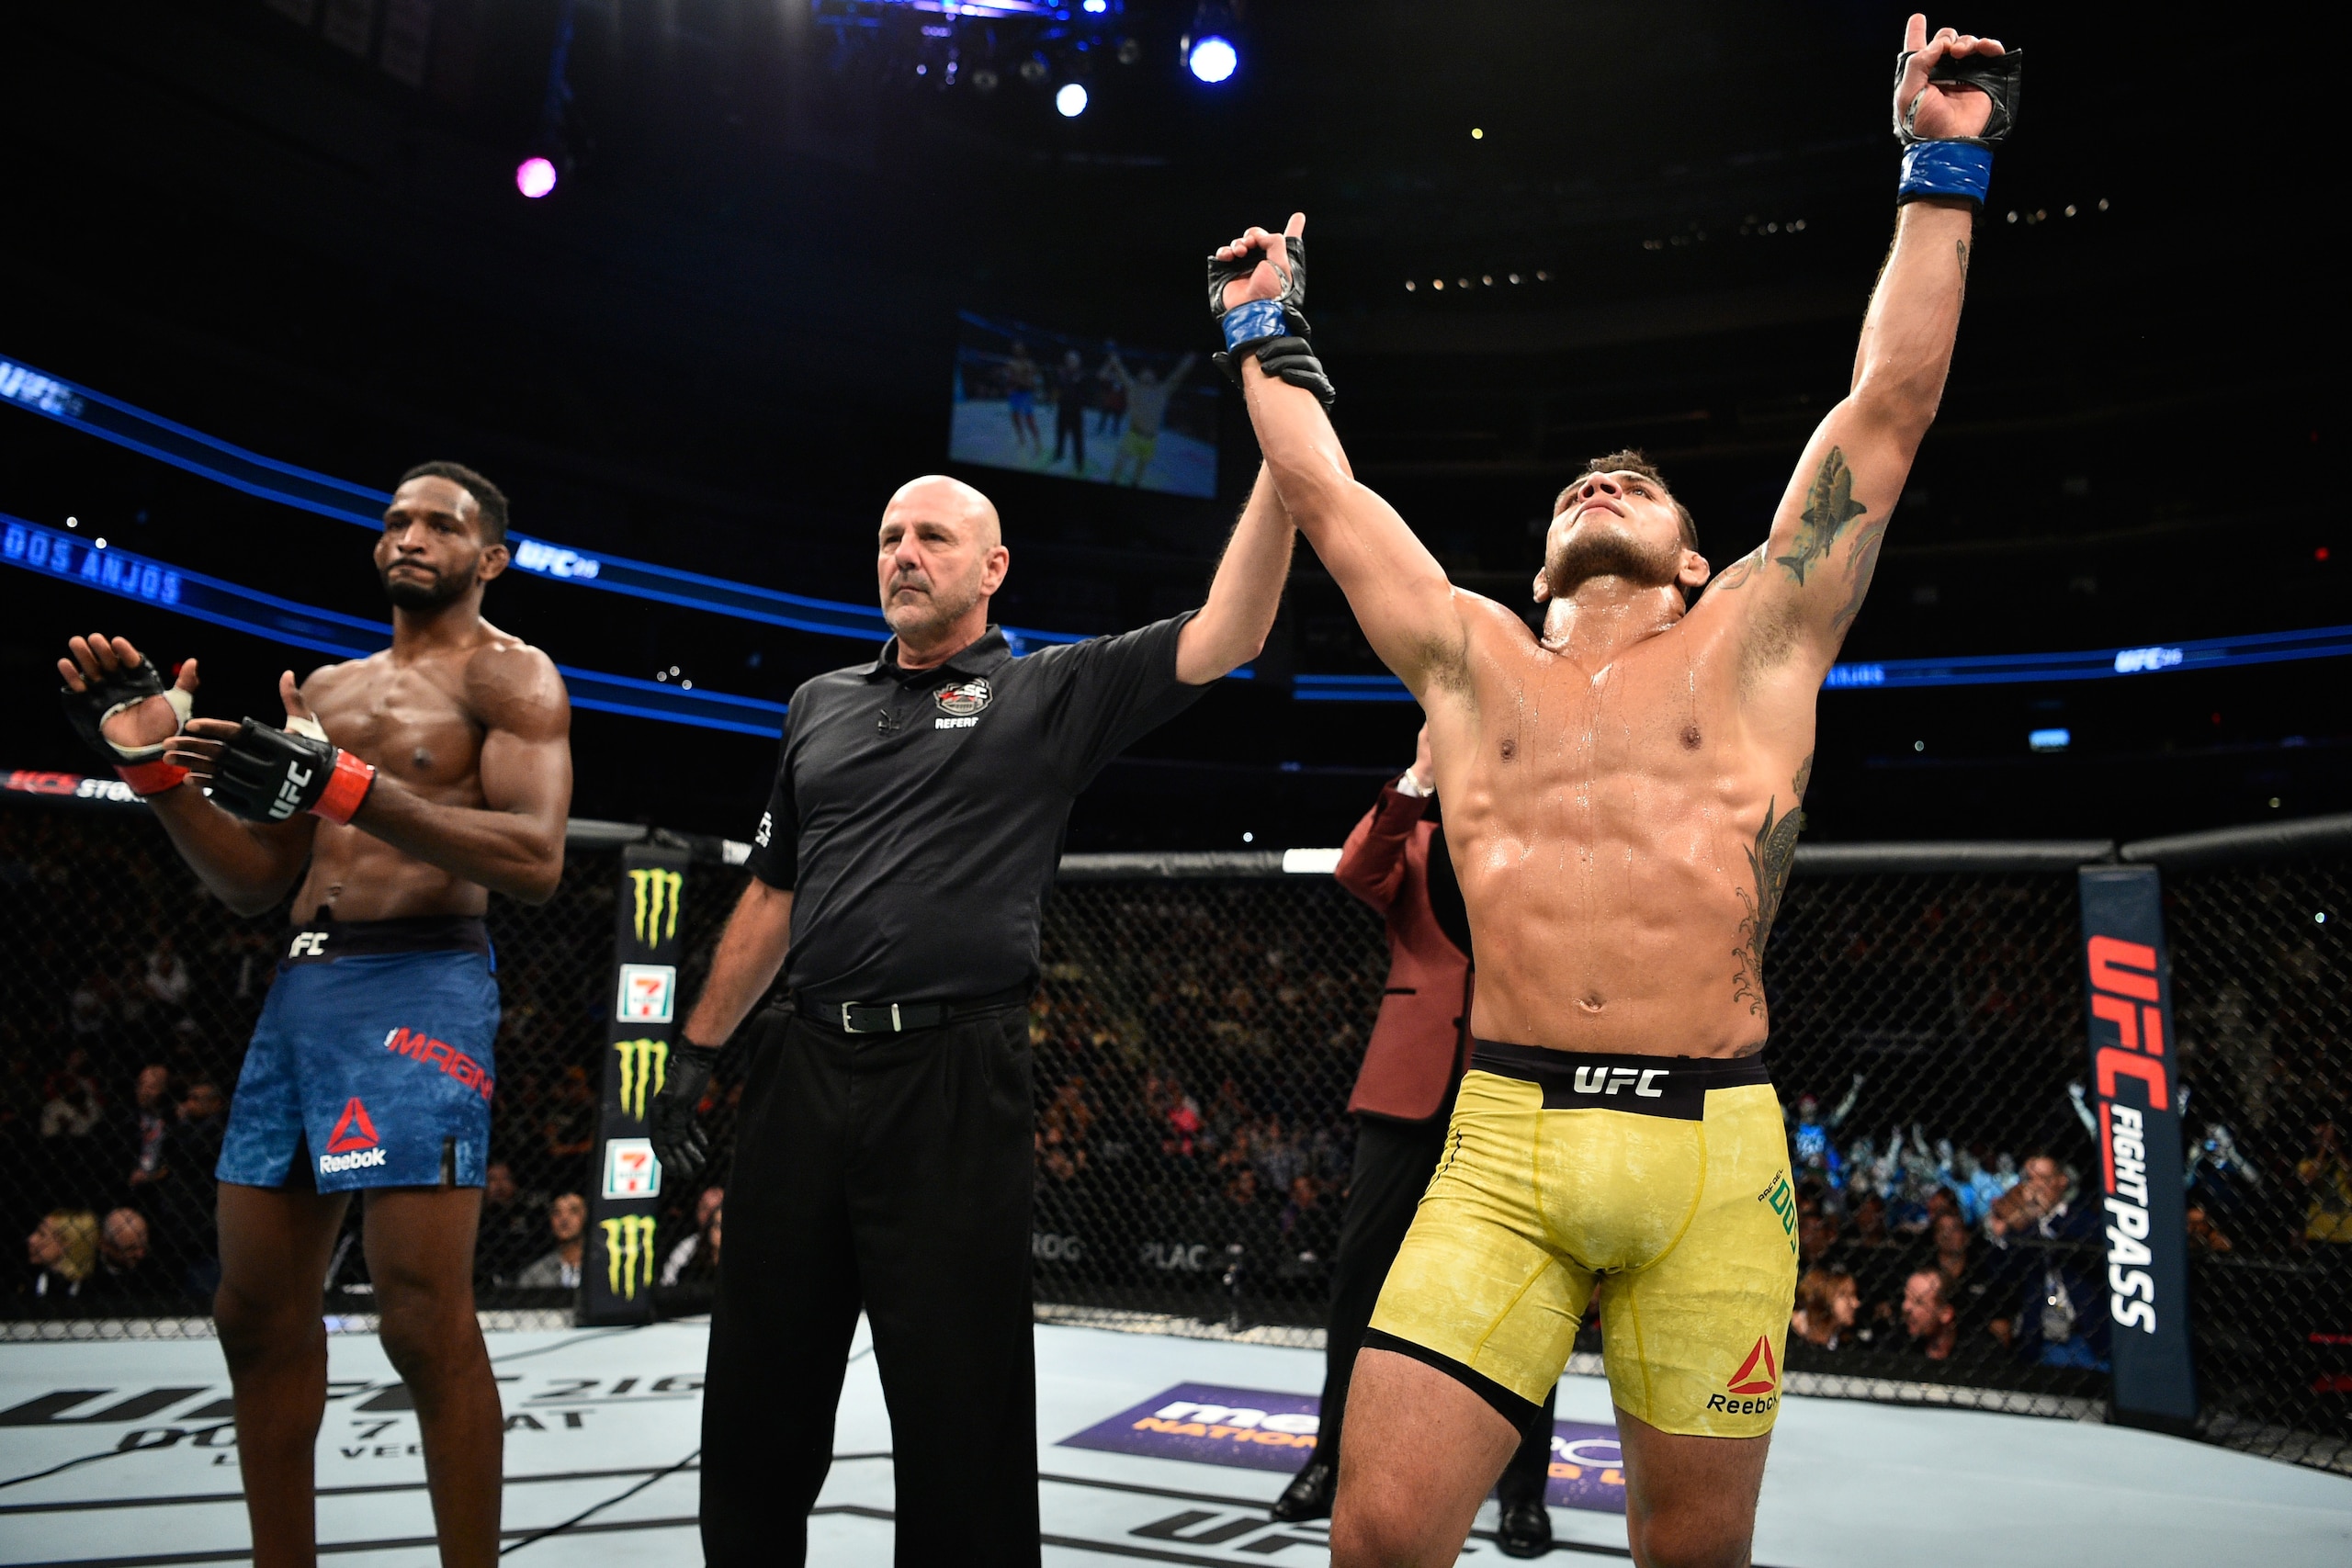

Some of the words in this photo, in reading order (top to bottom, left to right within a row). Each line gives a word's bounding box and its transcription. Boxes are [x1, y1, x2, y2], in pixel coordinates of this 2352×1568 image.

[4, 522, 72, 573] DOS
[79, 548, 182, 605] ANJOS
[268, 760, 312, 819] UFC
[2087, 934, 2169, 1111] UFC
[388, 1025, 494, 1102] MAGN
[1574, 1066, 1670, 1098] UFC
[319, 1146, 387, 1175] Reebok
[1758, 1168, 1784, 1202] RAFAEL
[2110, 1103, 2149, 1208] FIGHT
[2103, 1197, 2157, 1335] PASS
[1706, 1391, 1779, 1415] Reebok
